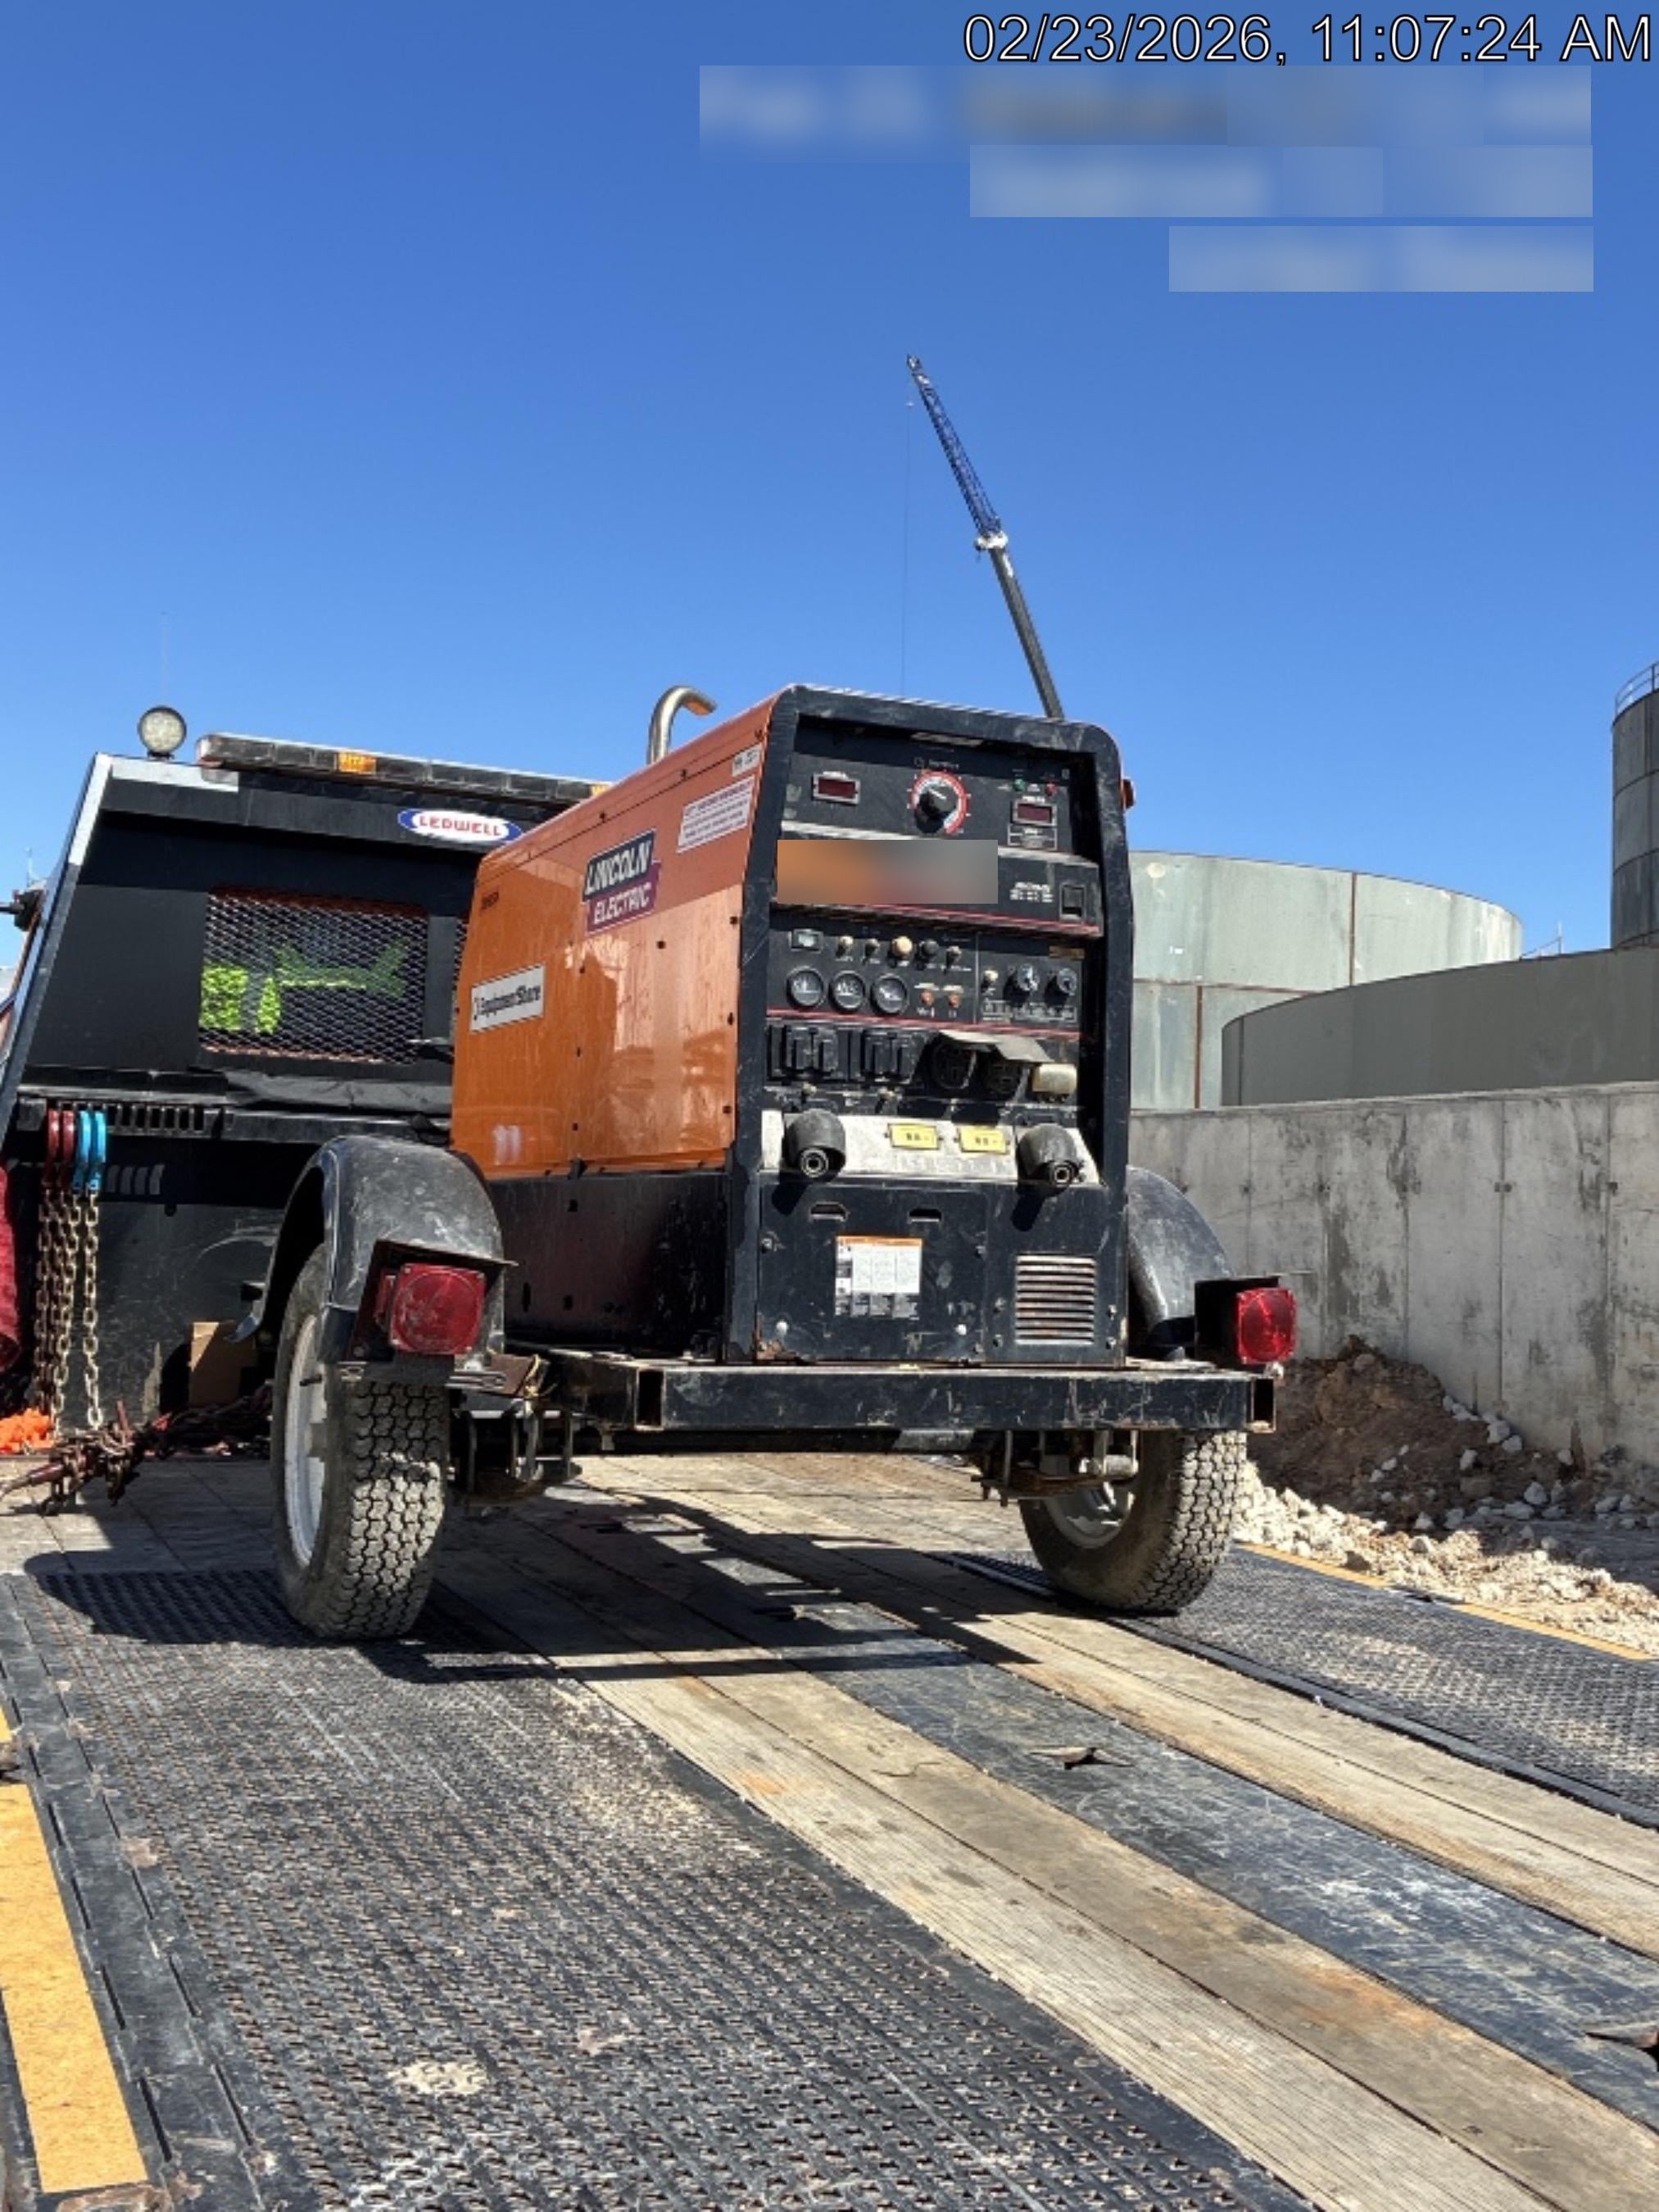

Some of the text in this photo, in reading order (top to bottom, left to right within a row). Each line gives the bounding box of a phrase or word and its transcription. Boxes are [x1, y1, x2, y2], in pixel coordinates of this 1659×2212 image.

[419, 815, 502, 836] LEDWELL
[584, 839, 652, 895] LINCOLN
[594, 882, 652, 925] ELECTRIC
